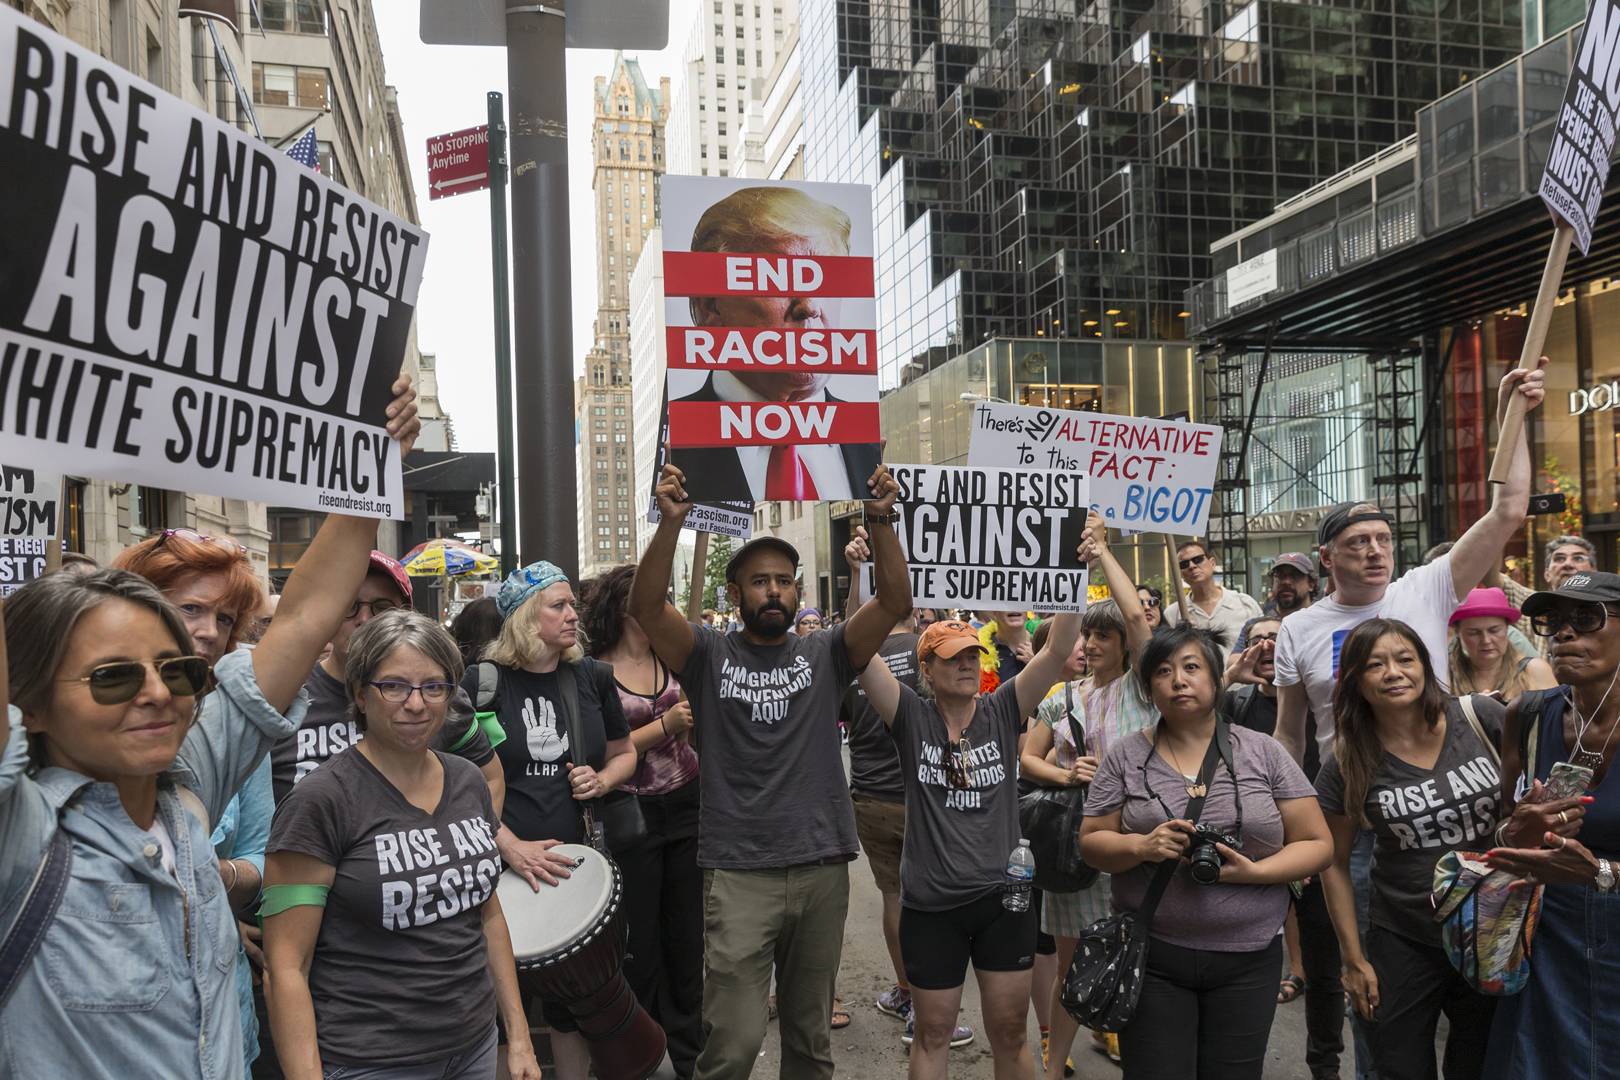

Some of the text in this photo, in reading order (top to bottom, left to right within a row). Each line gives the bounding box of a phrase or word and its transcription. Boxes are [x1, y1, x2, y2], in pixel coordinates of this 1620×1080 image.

[1574, 79, 1597, 119] THE
[1559, 102, 1594, 155] PENCE
[8, 26, 420, 299] RISE AND RESIST
[431, 142, 444, 155] NO
[432, 152, 470, 170] Anytime
[1549, 133, 1594, 202] MUST
[23, 164, 389, 416] AGAINST
[725, 256, 824, 292] END
[684, 330, 867, 366] RACISM
[719, 404, 838, 439] NOW
[977, 404, 1023, 433] There's
[1055, 416, 1214, 456] ALTERNATIVE
[165, 386, 390, 497] SUPREMACY
[1017, 442, 1034, 465] to
[1048, 446, 1079, 470] this
[318, 491, 392, 517] riseandresist.org
[889, 468, 1084, 508] SE AND RESIST
[1105, 507, 1115, 520] a
[1123, 484, 1213, 526] BIGOT
[698, 521, 708, 530] el
[709, 523, 742, 536] Fascismo
[14, 539, 67, 556] REGIE
[945, 568, 1082, 604] SUPREMACY
[1032, 602, 1080, 613] riseandresist.org
[525, 763, 559, 777] LLAP
[917, 763, 1006, 789] BIENNIDOS
[1378, 756, 1501, 819] RISE AND
[945, 790, 981, 811] AQUI
[374, 827, 449, 876] RISE
